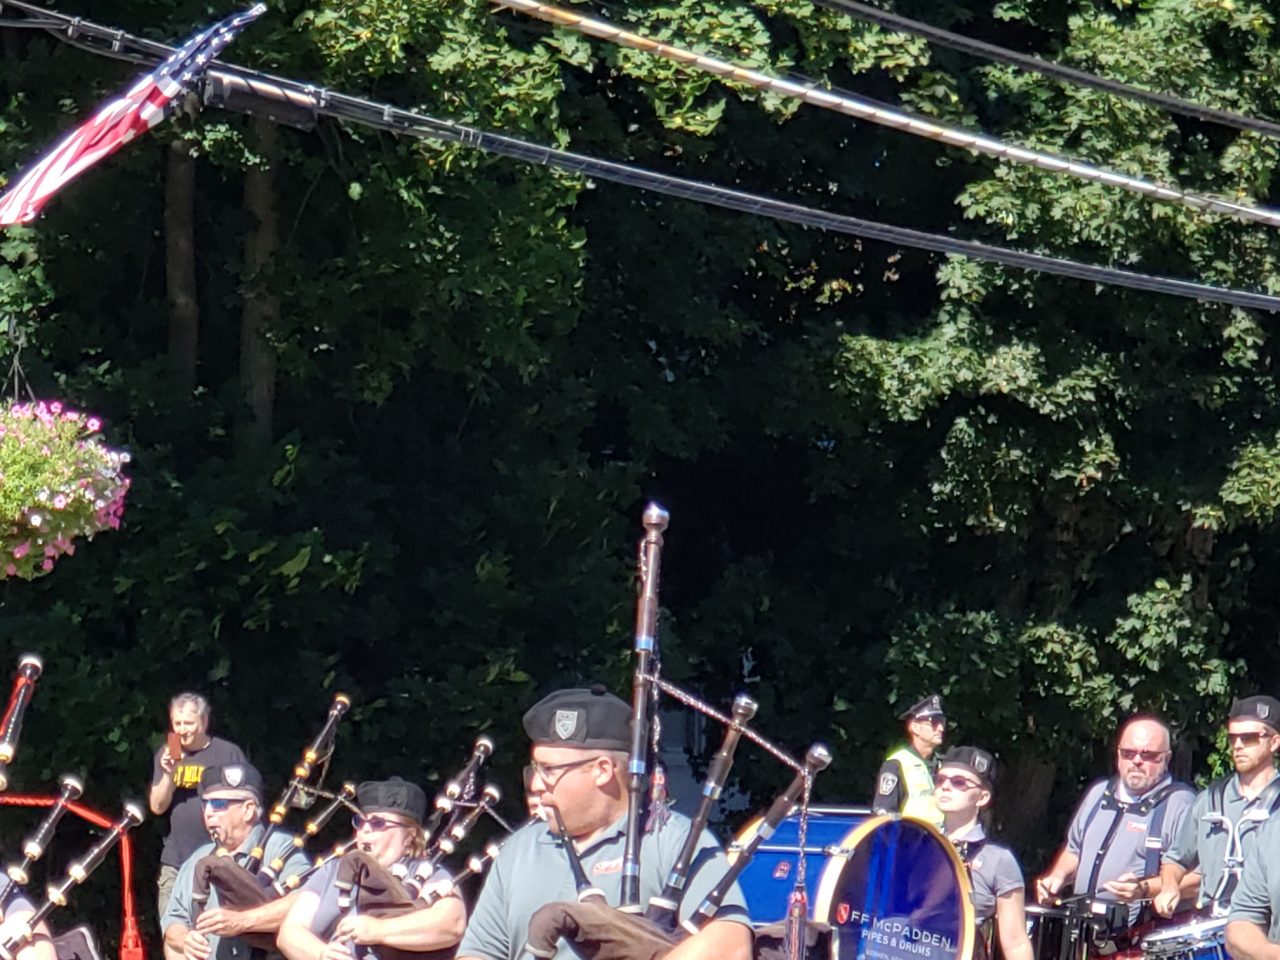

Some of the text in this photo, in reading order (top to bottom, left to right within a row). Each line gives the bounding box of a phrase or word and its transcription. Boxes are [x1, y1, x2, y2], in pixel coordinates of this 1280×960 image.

[851, 911, 951, 948] FF McPADDEN
[862, 929, 931, 957] PIPES & DRUMS
